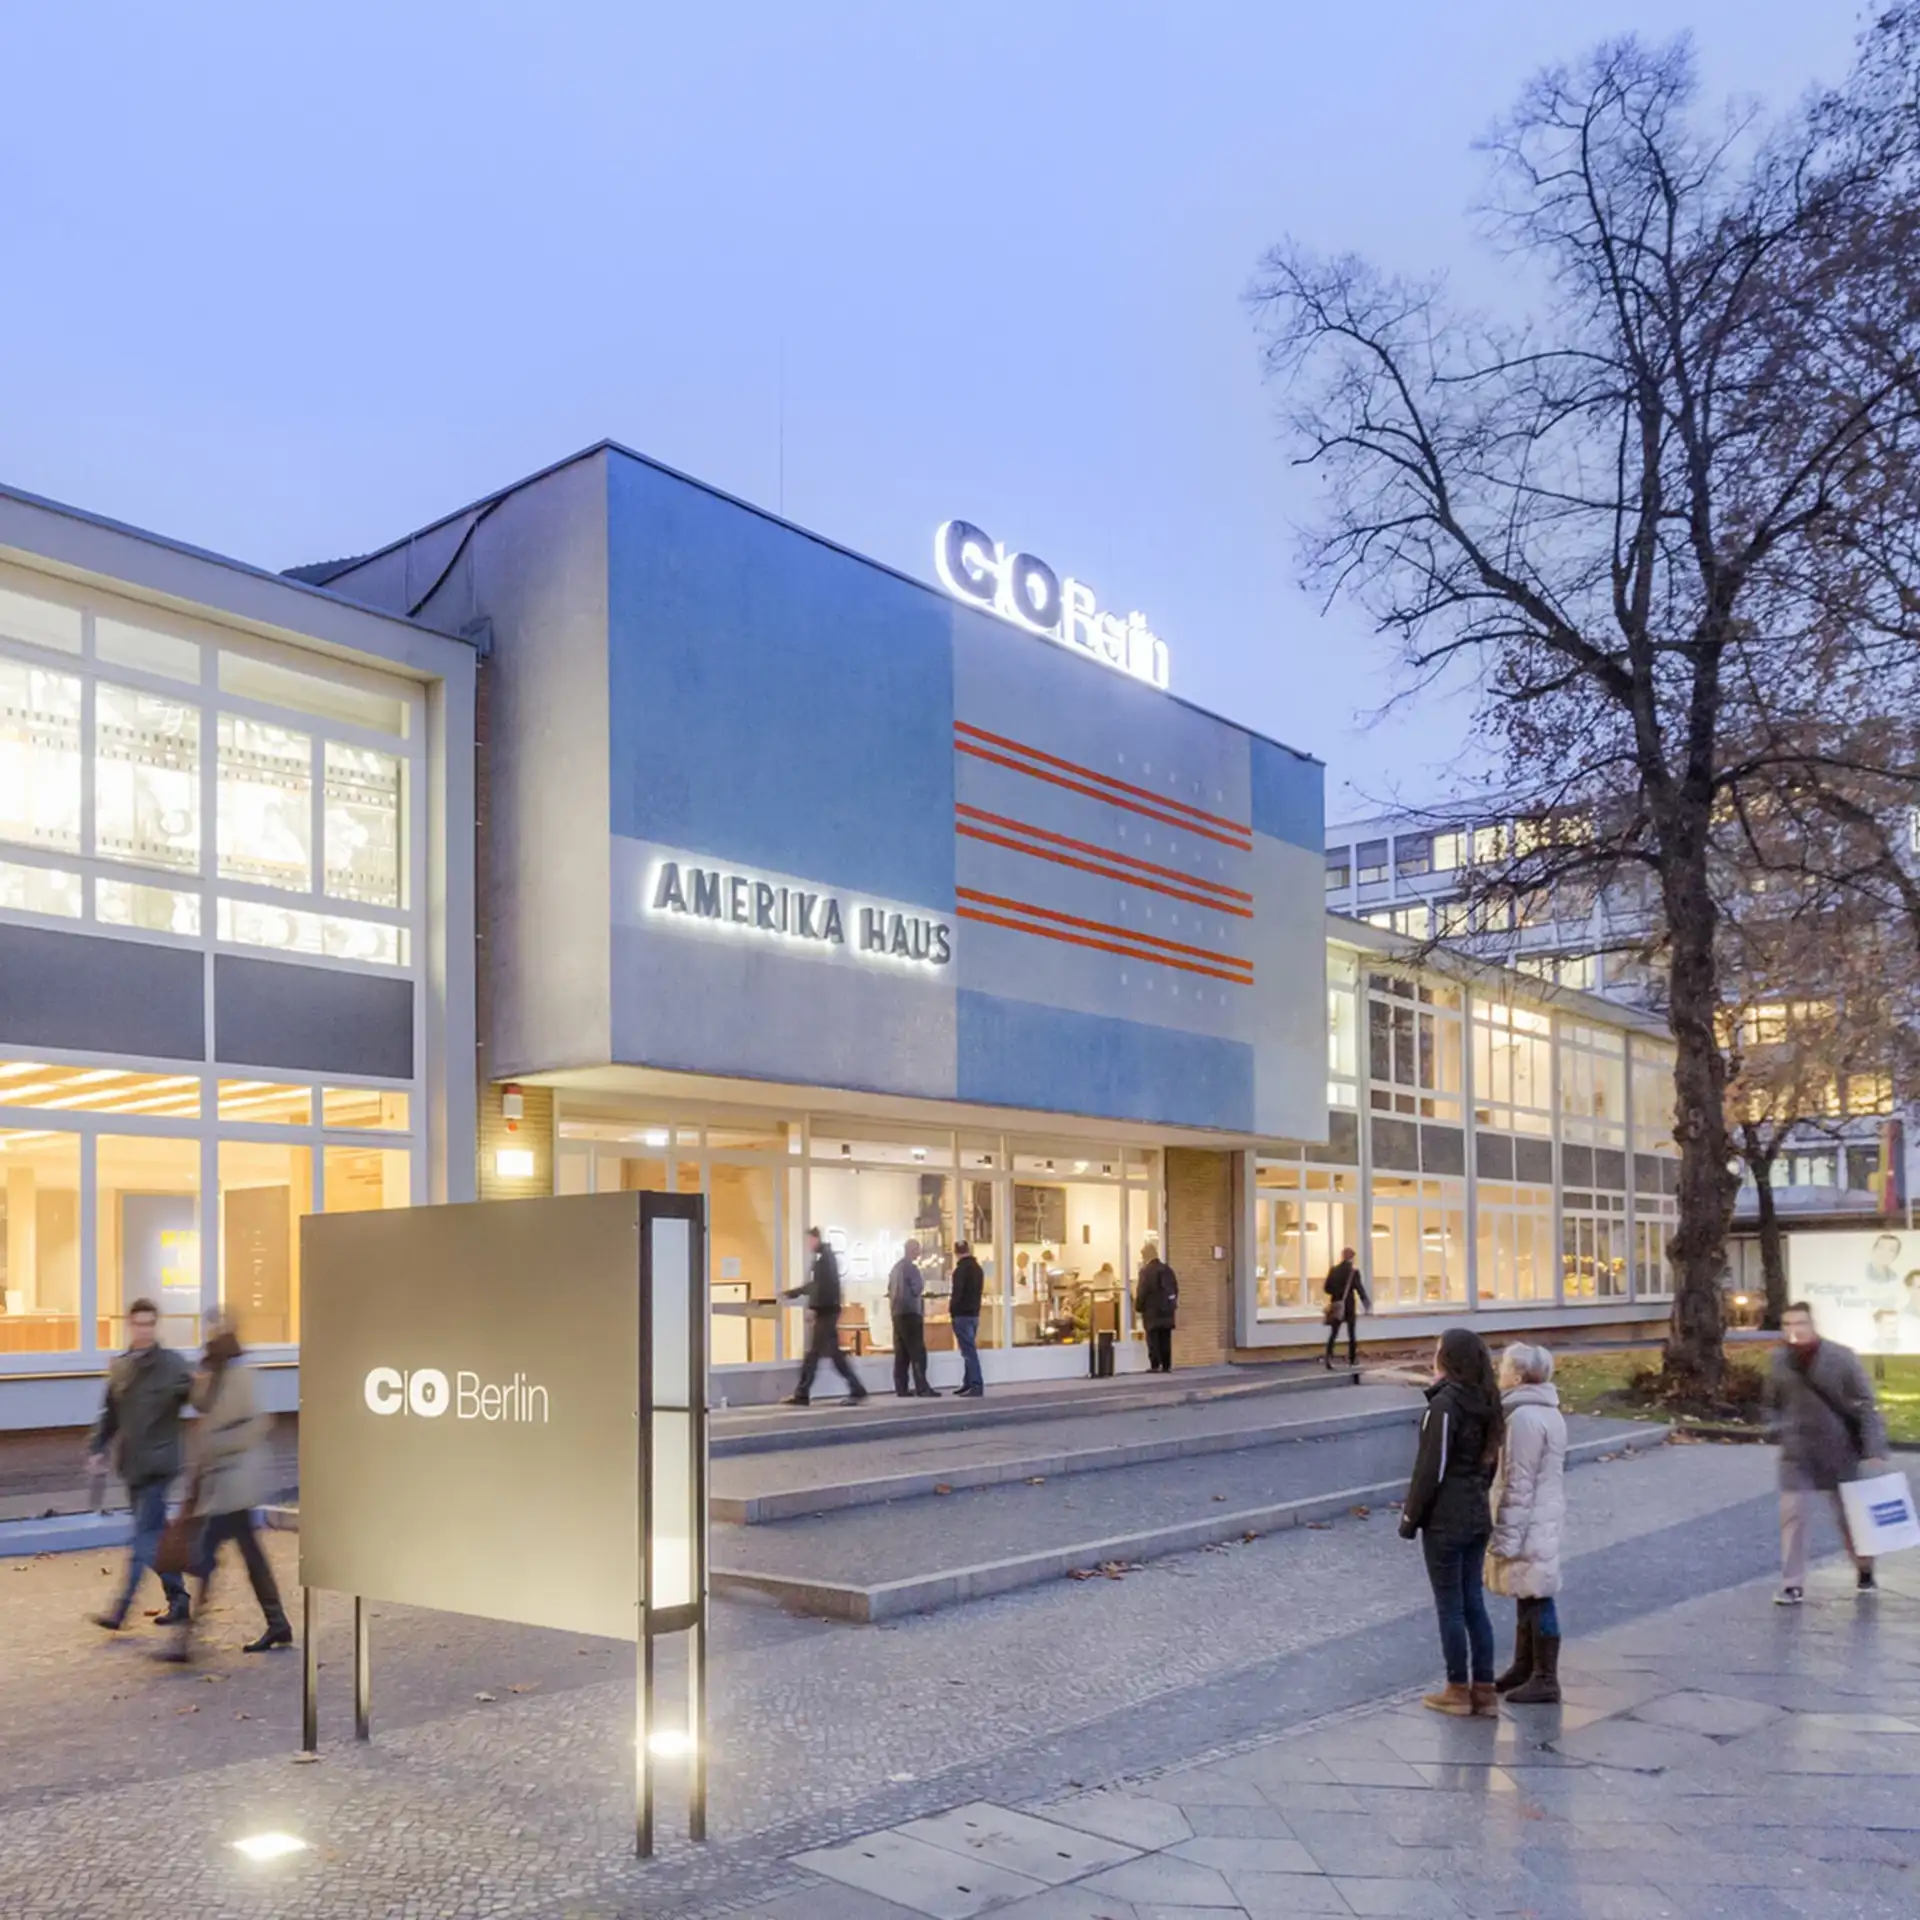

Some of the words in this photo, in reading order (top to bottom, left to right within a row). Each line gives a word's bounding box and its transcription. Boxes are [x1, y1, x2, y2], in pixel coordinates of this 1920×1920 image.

[652, 862, 845, 944] AMERIKA
[859, 907, 951, 964] HAUS
[457, 1371, 548, 1422] Berlin
